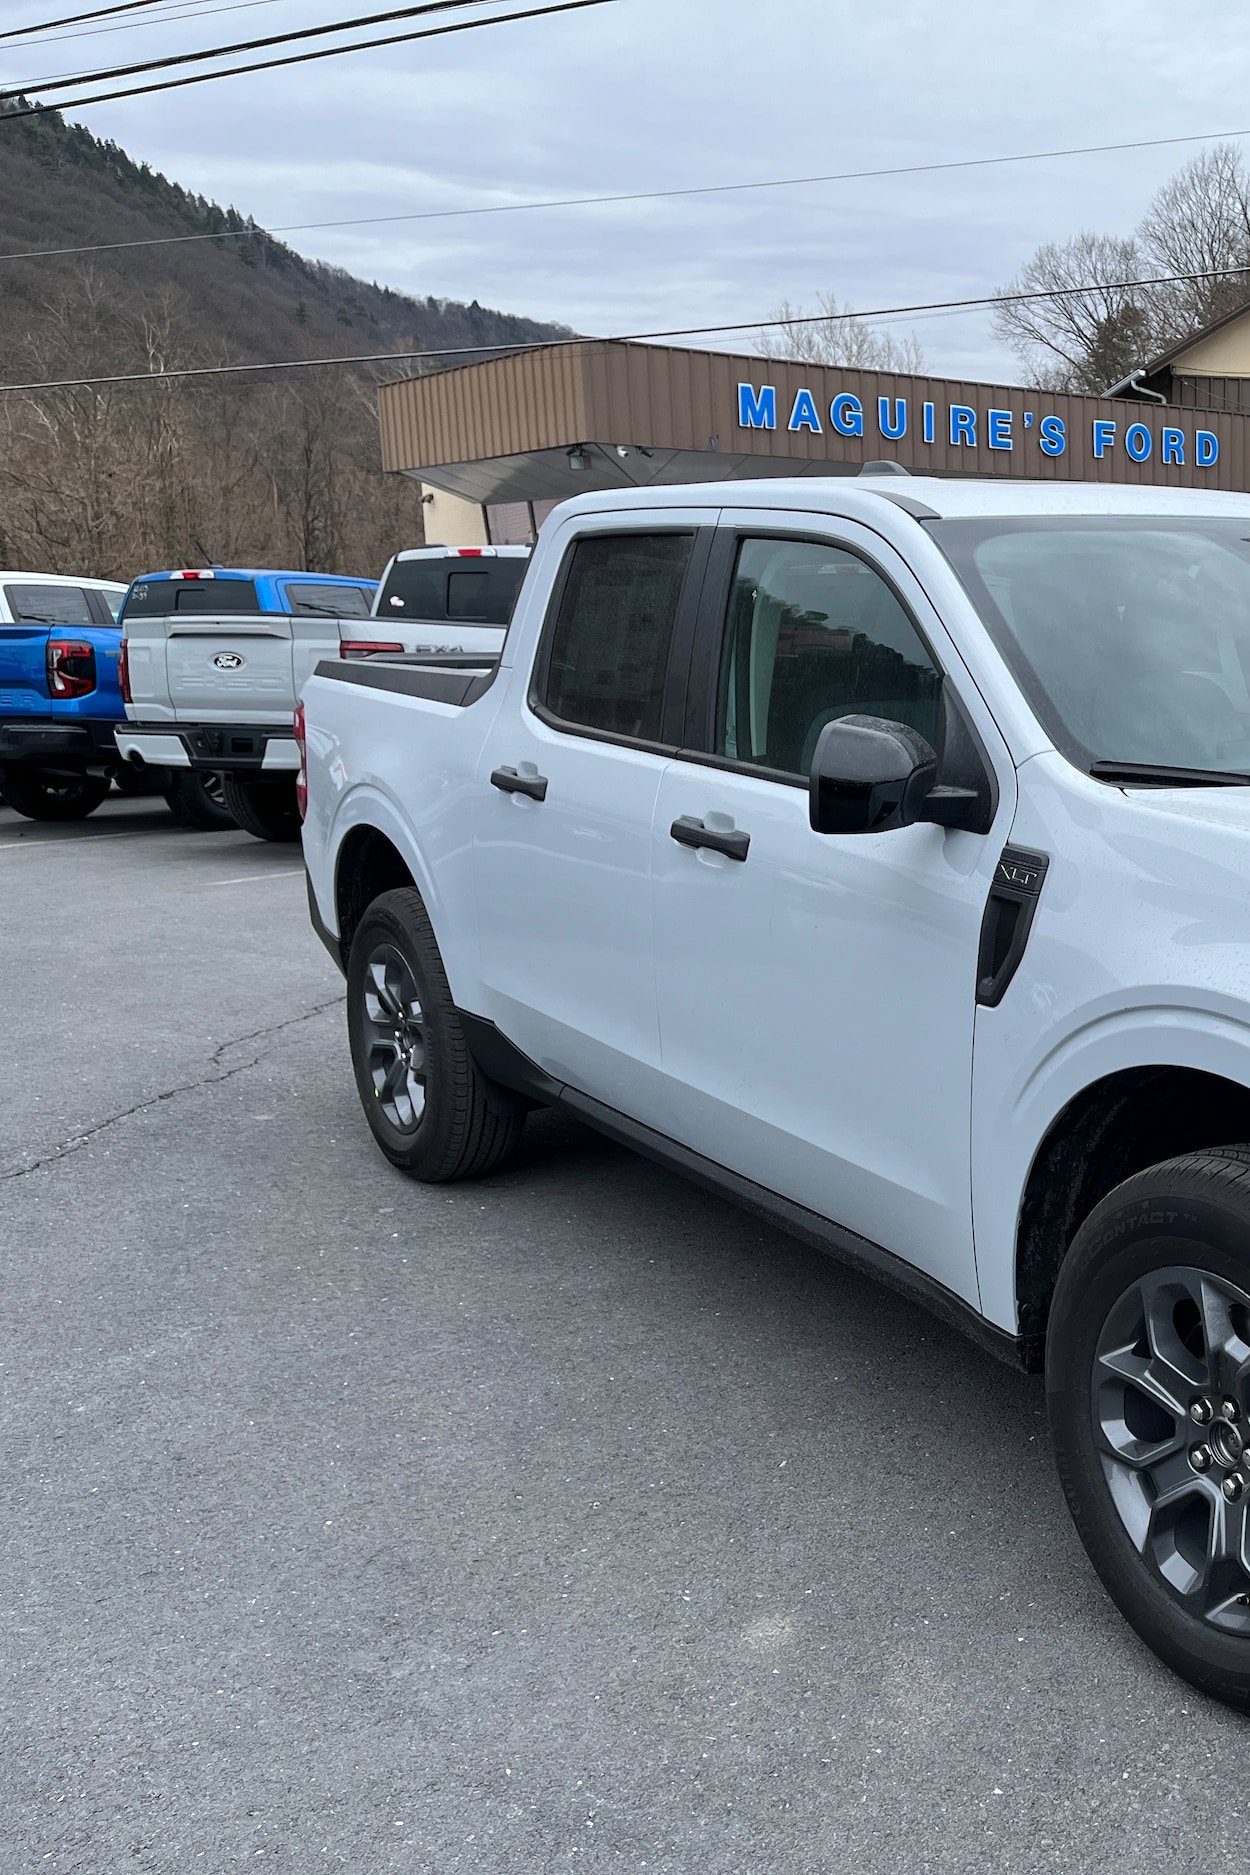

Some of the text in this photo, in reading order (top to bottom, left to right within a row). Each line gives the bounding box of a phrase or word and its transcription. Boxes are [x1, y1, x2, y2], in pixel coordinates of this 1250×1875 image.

[737, 383, 1220, 467] MAGUIRE'S FORD
[216, 655, 239, 667] Ford
[994, 863, 1038, 885] XLT
